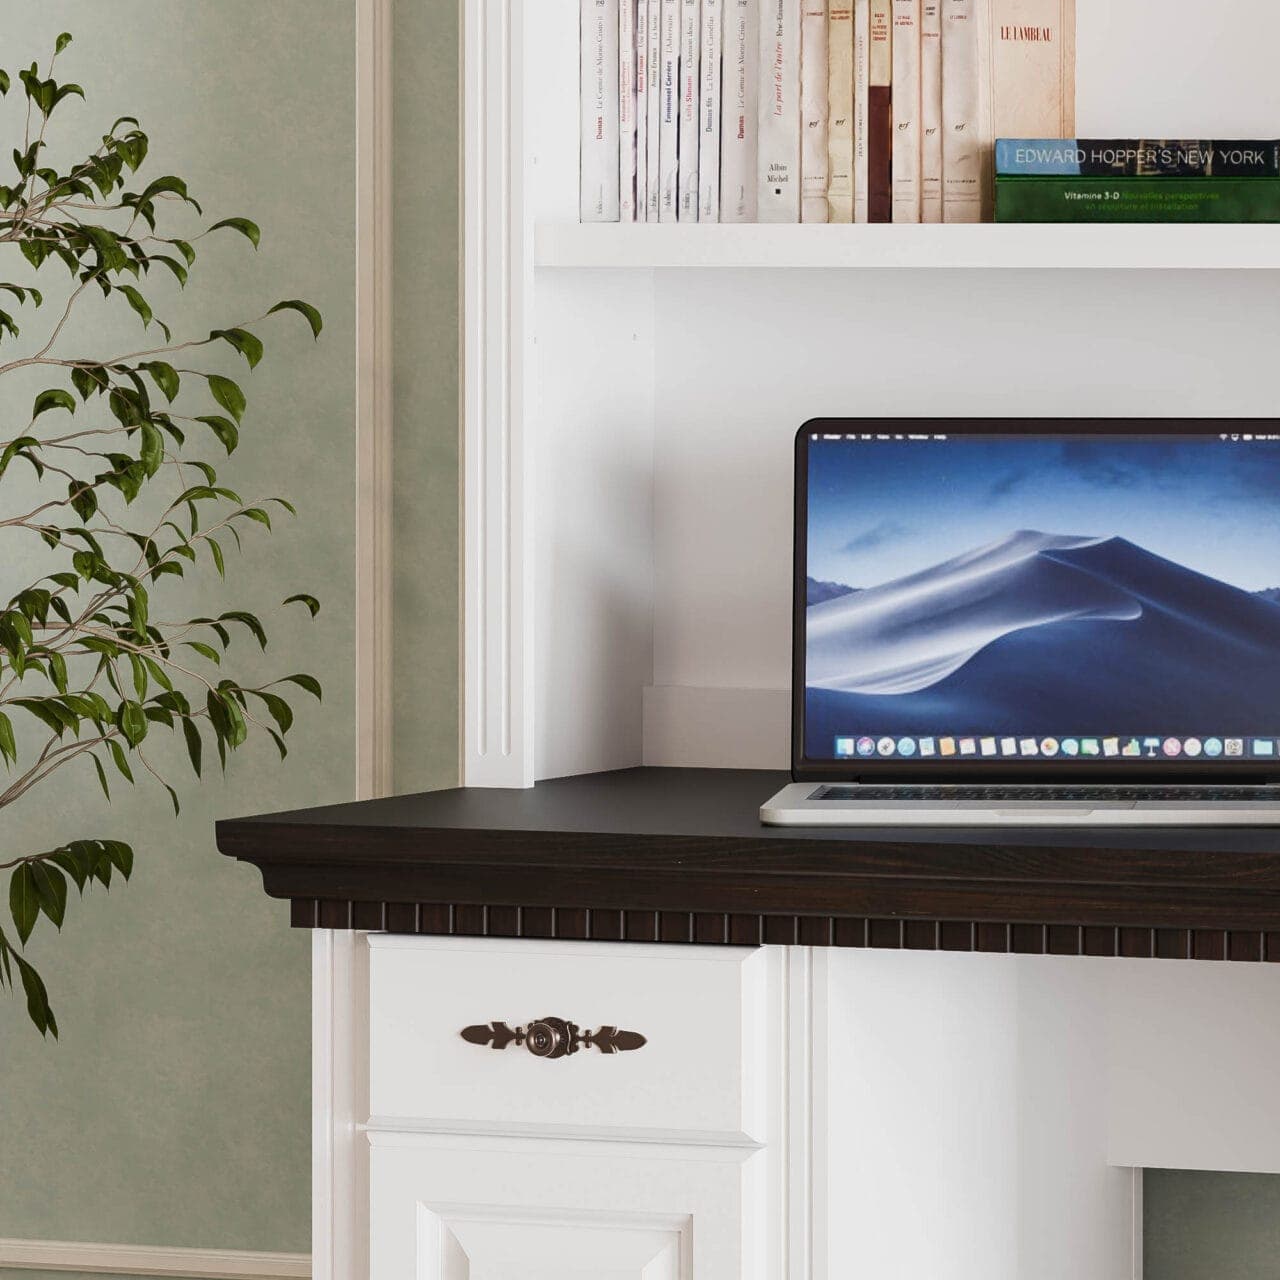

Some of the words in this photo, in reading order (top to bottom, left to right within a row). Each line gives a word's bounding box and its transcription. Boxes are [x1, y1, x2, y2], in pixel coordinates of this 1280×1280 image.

[774, 72, 783, 82] de
[774, 85, 784, 103] part
[1015, 149, 1086, 164] EDWARD
[1091, 149, 1172, 164] HOPPER'S
[1177, 149, 1215, 164] NEW
[1219, 150, 1265, 165] YORK
[769, 163, 787, 171] Albin
[767, 175, 789, 183] Michel
[1064, 191, 1102, 200] Vitamine
